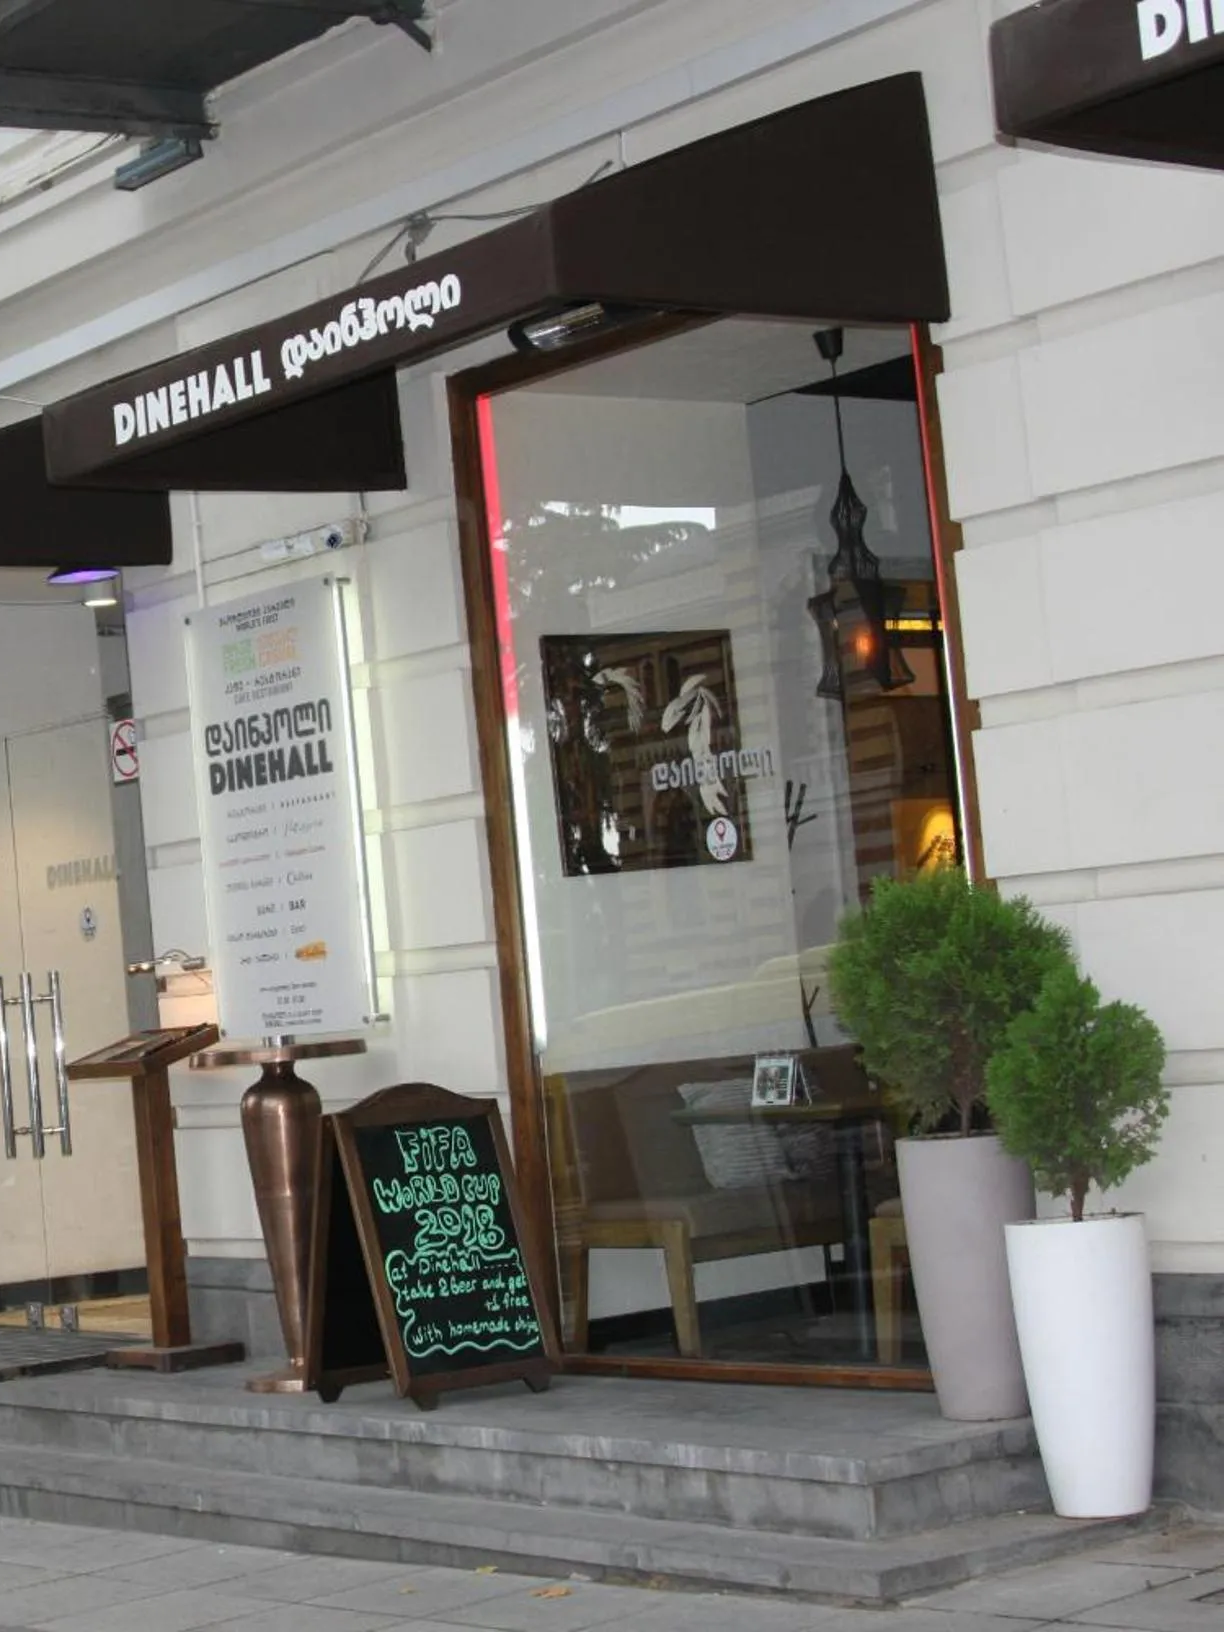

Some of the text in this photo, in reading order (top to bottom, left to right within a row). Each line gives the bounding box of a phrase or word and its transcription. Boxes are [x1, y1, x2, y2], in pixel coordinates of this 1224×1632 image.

[113, 350, 272, 446] DINEHALL
[209, 740, 333, 795] DINEHALL
[461, 1173, 500, 1205] CUP
[414, 1204, 505, 1250] 2018
[391, 1254, 480, 1281] at Dinehall
[401, 1280, 435, 1301] take
[482, 1271, 506, 1290] and
[508, 1273, 528, 1295] get
[502, 1292, 530, 1309] free
[449, 1317, 511, 1338] homemade
